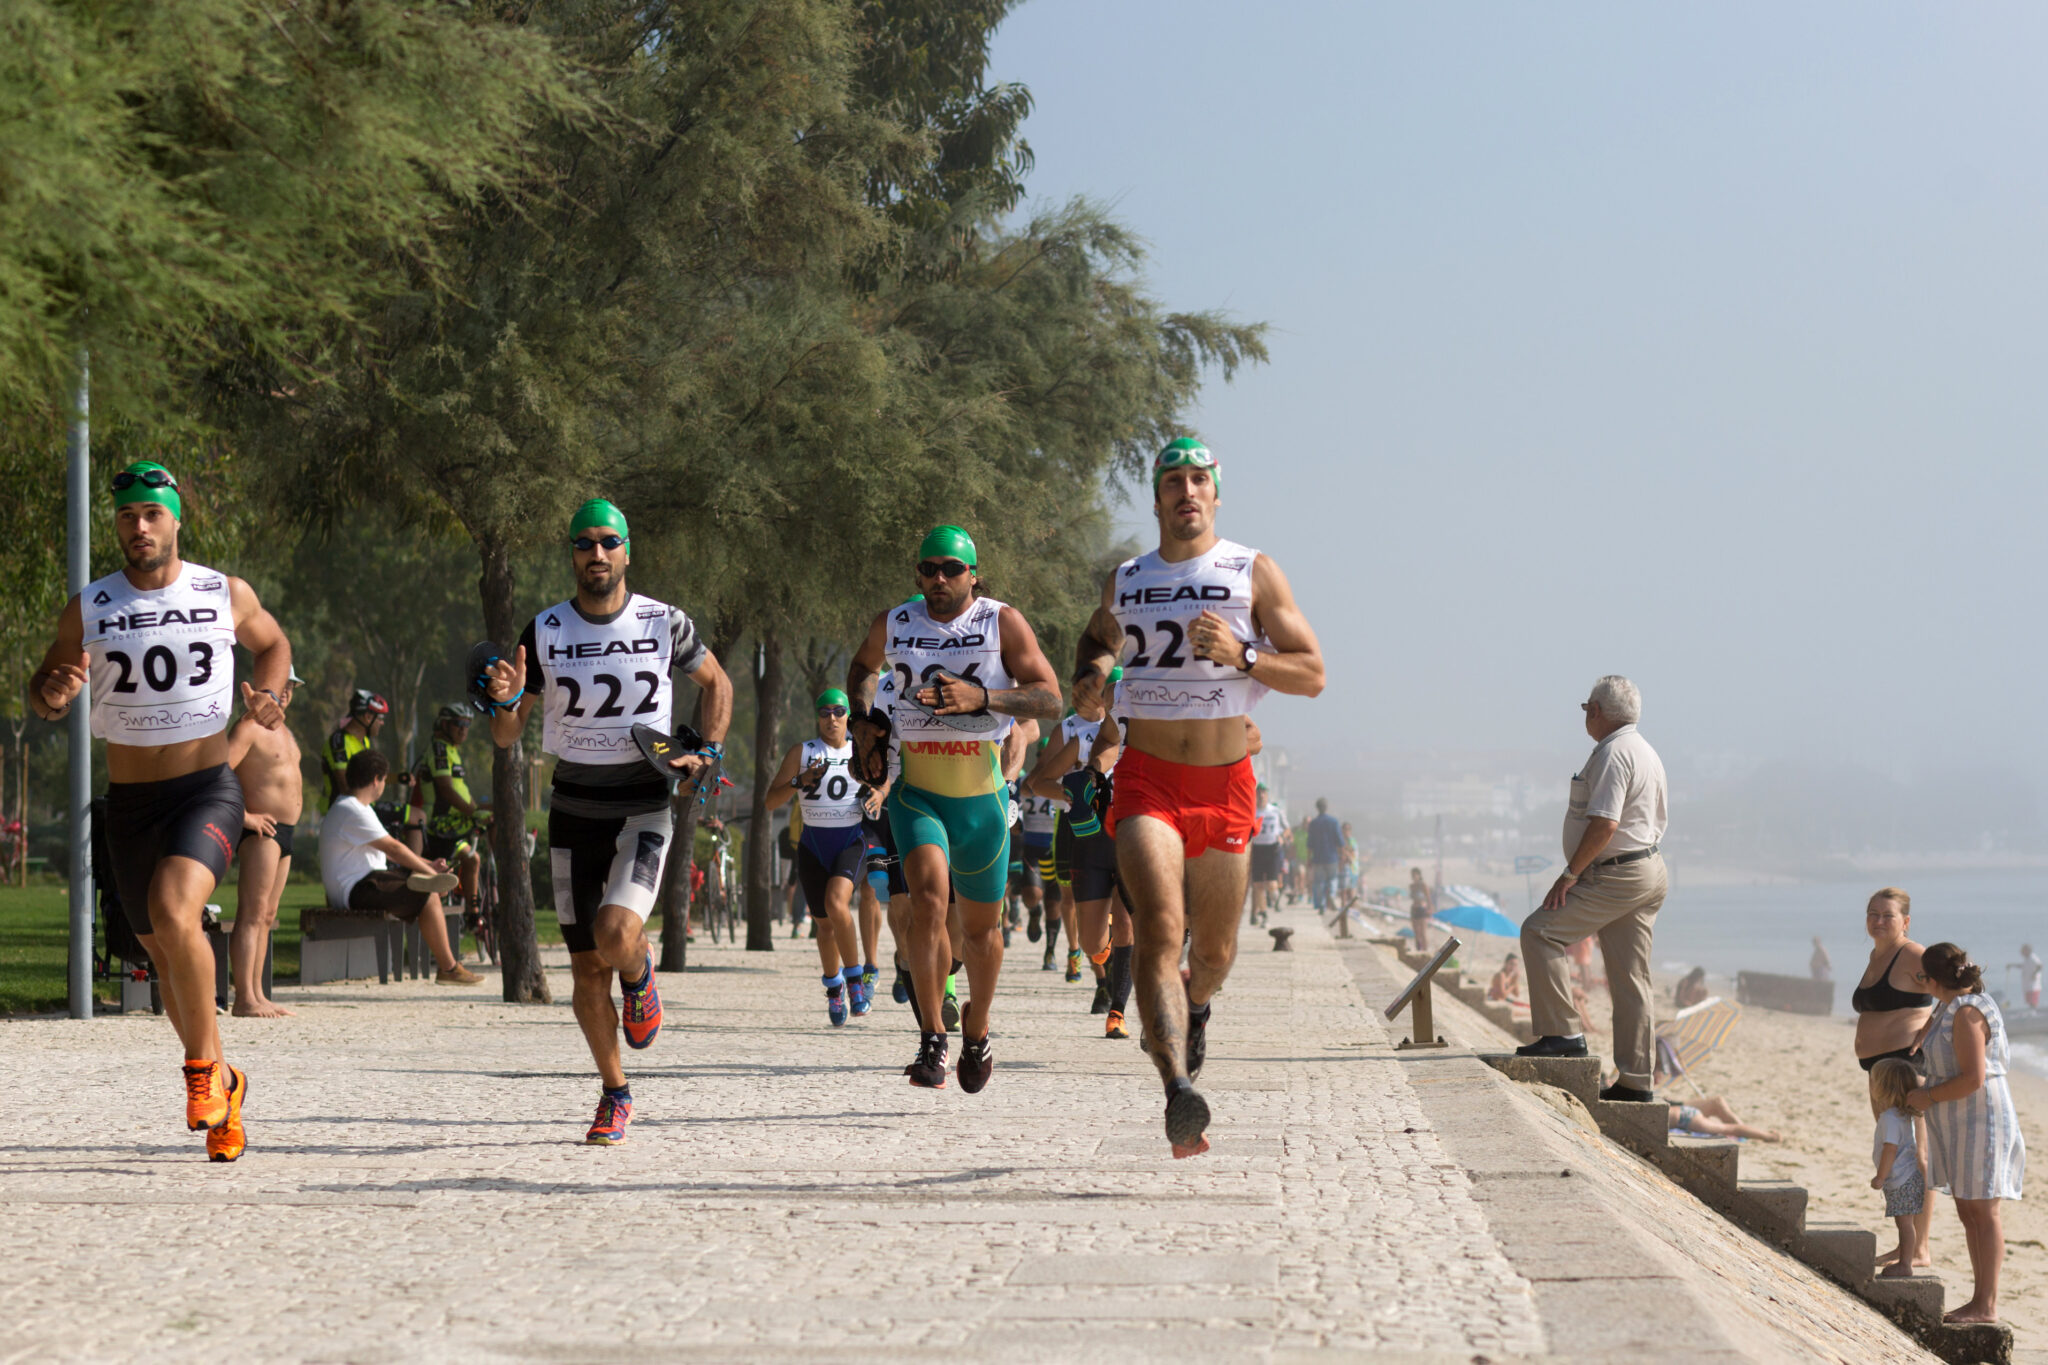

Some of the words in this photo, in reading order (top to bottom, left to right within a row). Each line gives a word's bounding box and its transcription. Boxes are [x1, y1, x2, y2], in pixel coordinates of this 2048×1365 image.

[1120, 585, 1231, 607] HEAD
[98, 608, 218, 634] HEAD
[1128, 606, 1173, 615] PORTUGAL
[112, 630, 163, 641] PORTUGAL
[176, 626, 209, 634] SERIES
[893, 634, 985, 650] HEAD
[549, 638, 659, 660] HEAD
[105, 642, 214, 693] 203
[560, 660, 607, 669] PORTUGAL
[556, 671, 659, 718] 222
